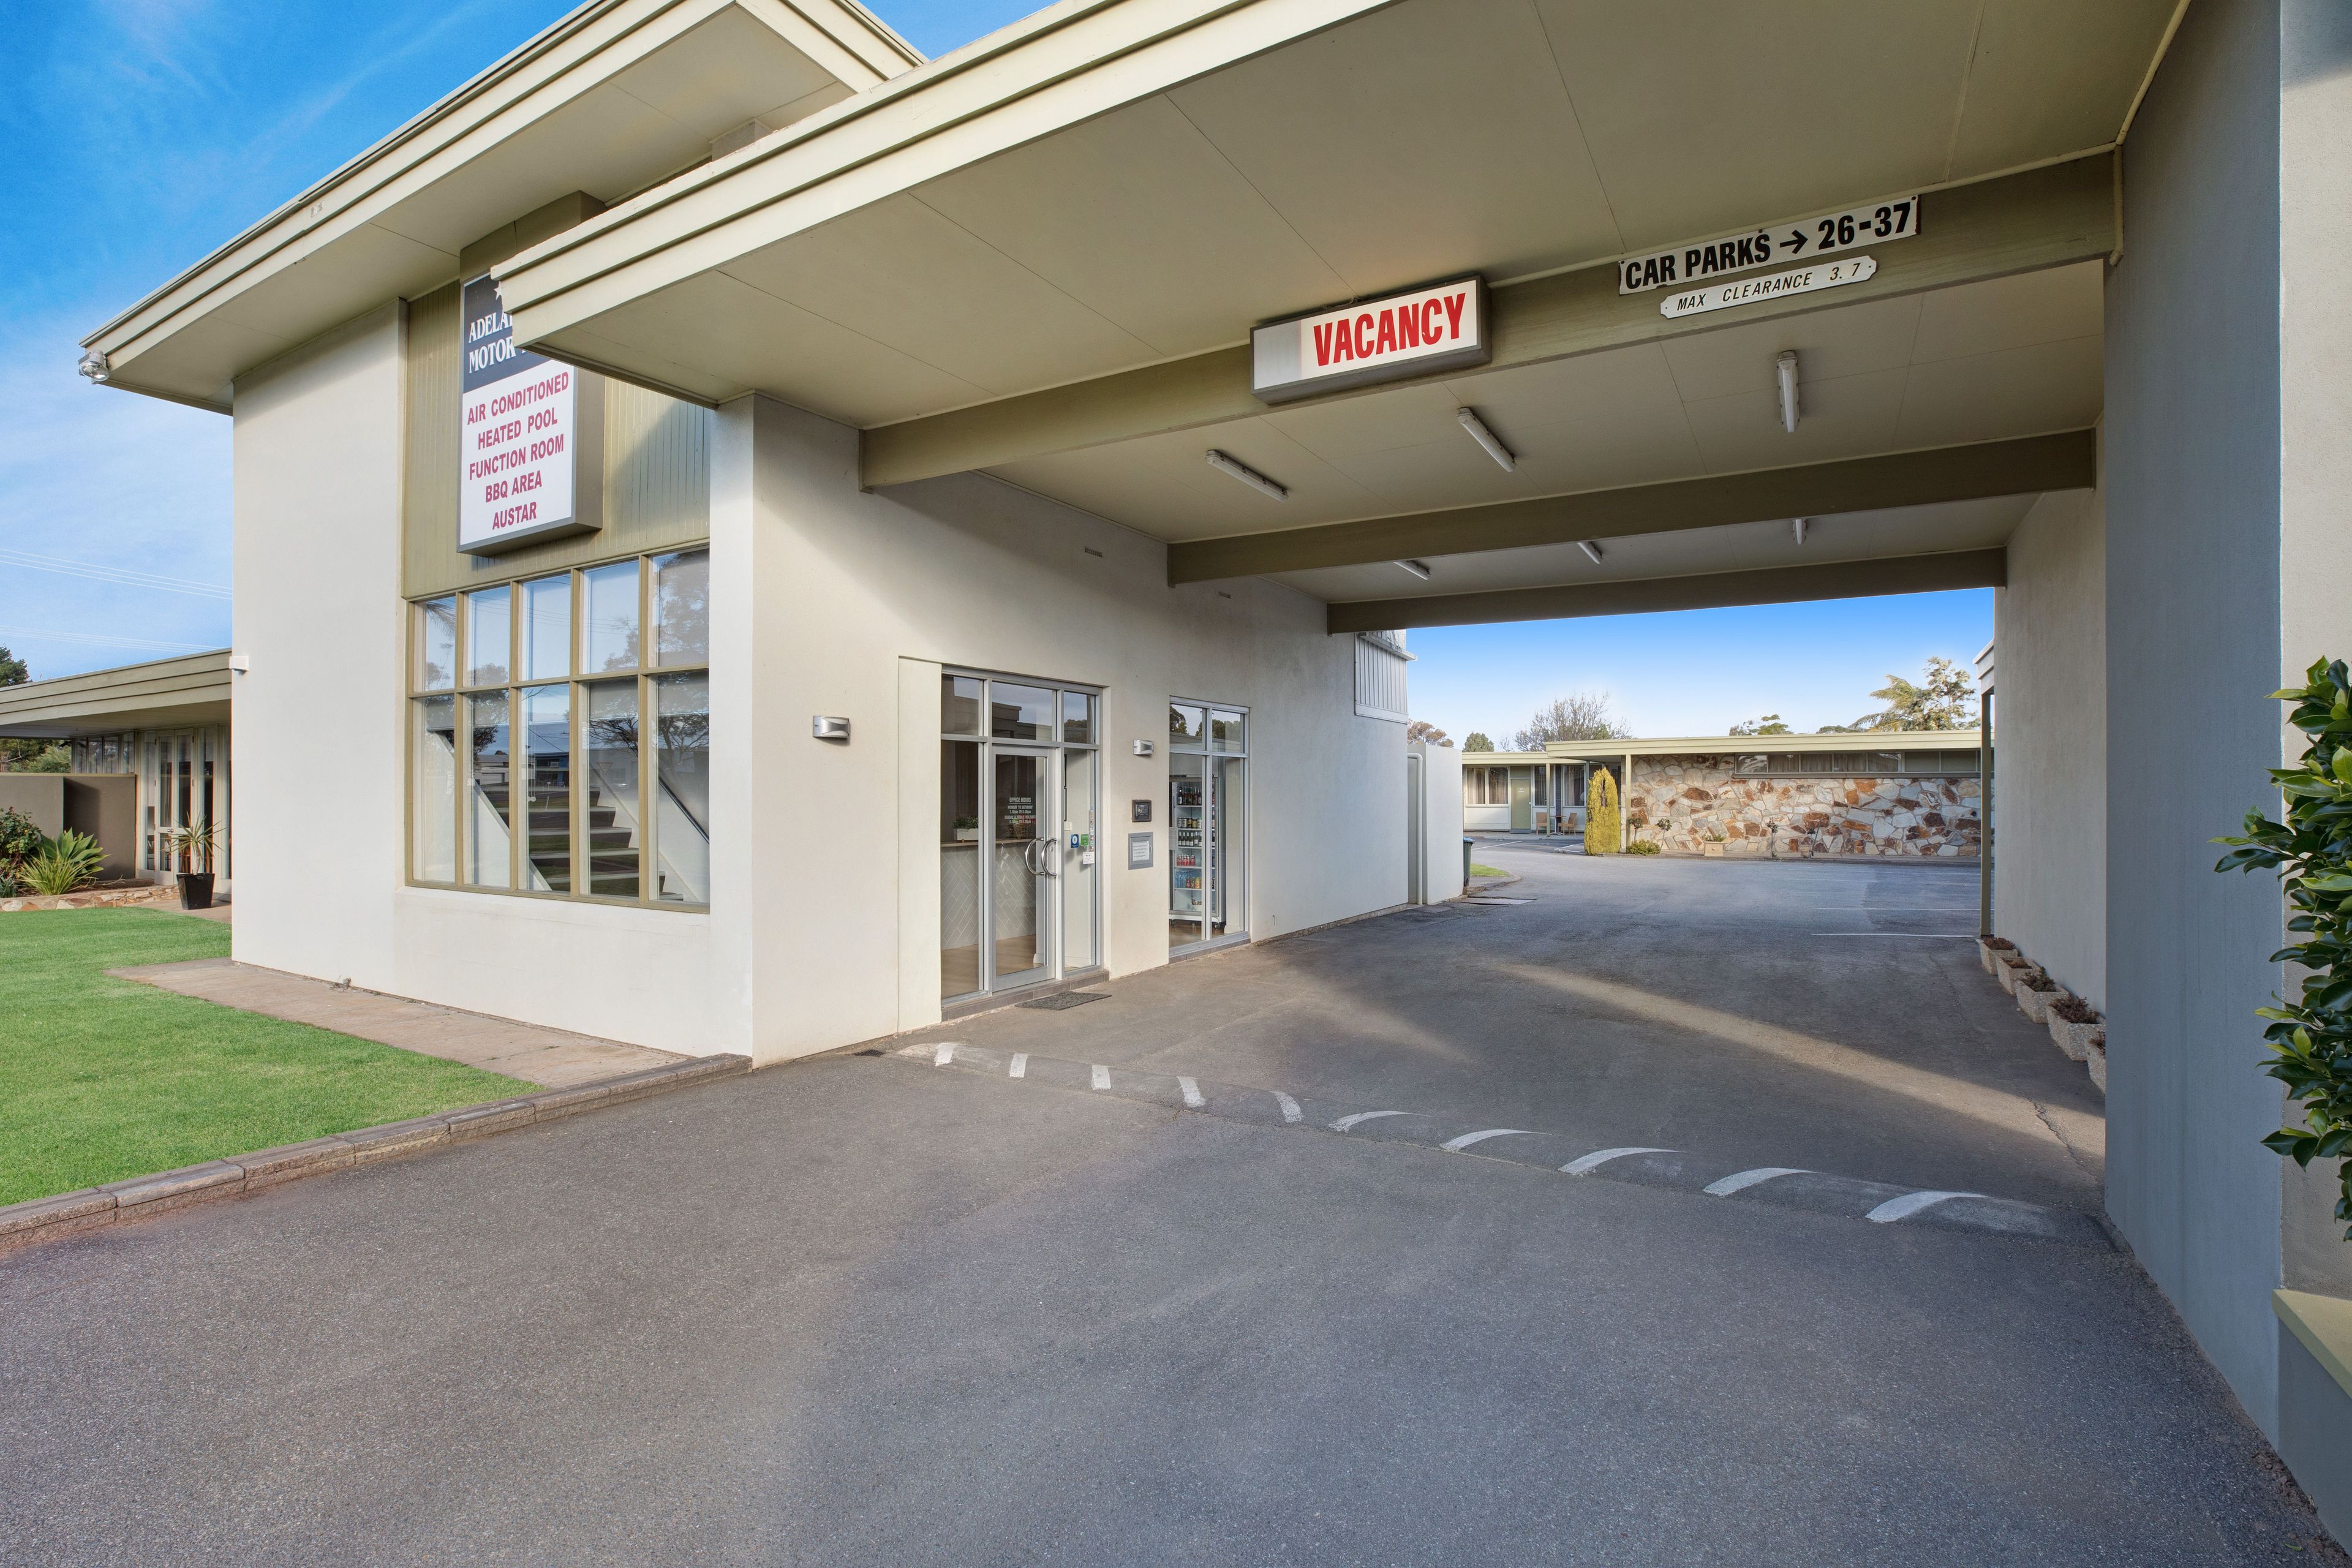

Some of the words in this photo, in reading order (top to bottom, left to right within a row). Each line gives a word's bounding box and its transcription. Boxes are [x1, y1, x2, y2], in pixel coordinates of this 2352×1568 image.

[1626, 255, 1676, 290] CAR
[1686, 234, 1771, 277] PARKS
[1818, 202, 1910, 250] 26-37
[1676, 293, 1706, 311] MAX
[1722, 272, 1813, 302] CLEARANCE
[1313, 293, 1466, 366] VACANCY
[469, 336, 516, 374] MOTOR
[467, 403, 486, 425] AIR
[491, 372, 569, 417] CONDITIONED
[478, 420, 521, 450] HEATED
[528, 407, 558, 434] POOL
[469, 447, 526, 481] FUNCTION
[530, 433, 564, 462] ROOM
[486, 480, 508, 503] BBQ
[511, 470, 542, 496] AREA
[492, 501, 537, 530] AUSTAR
